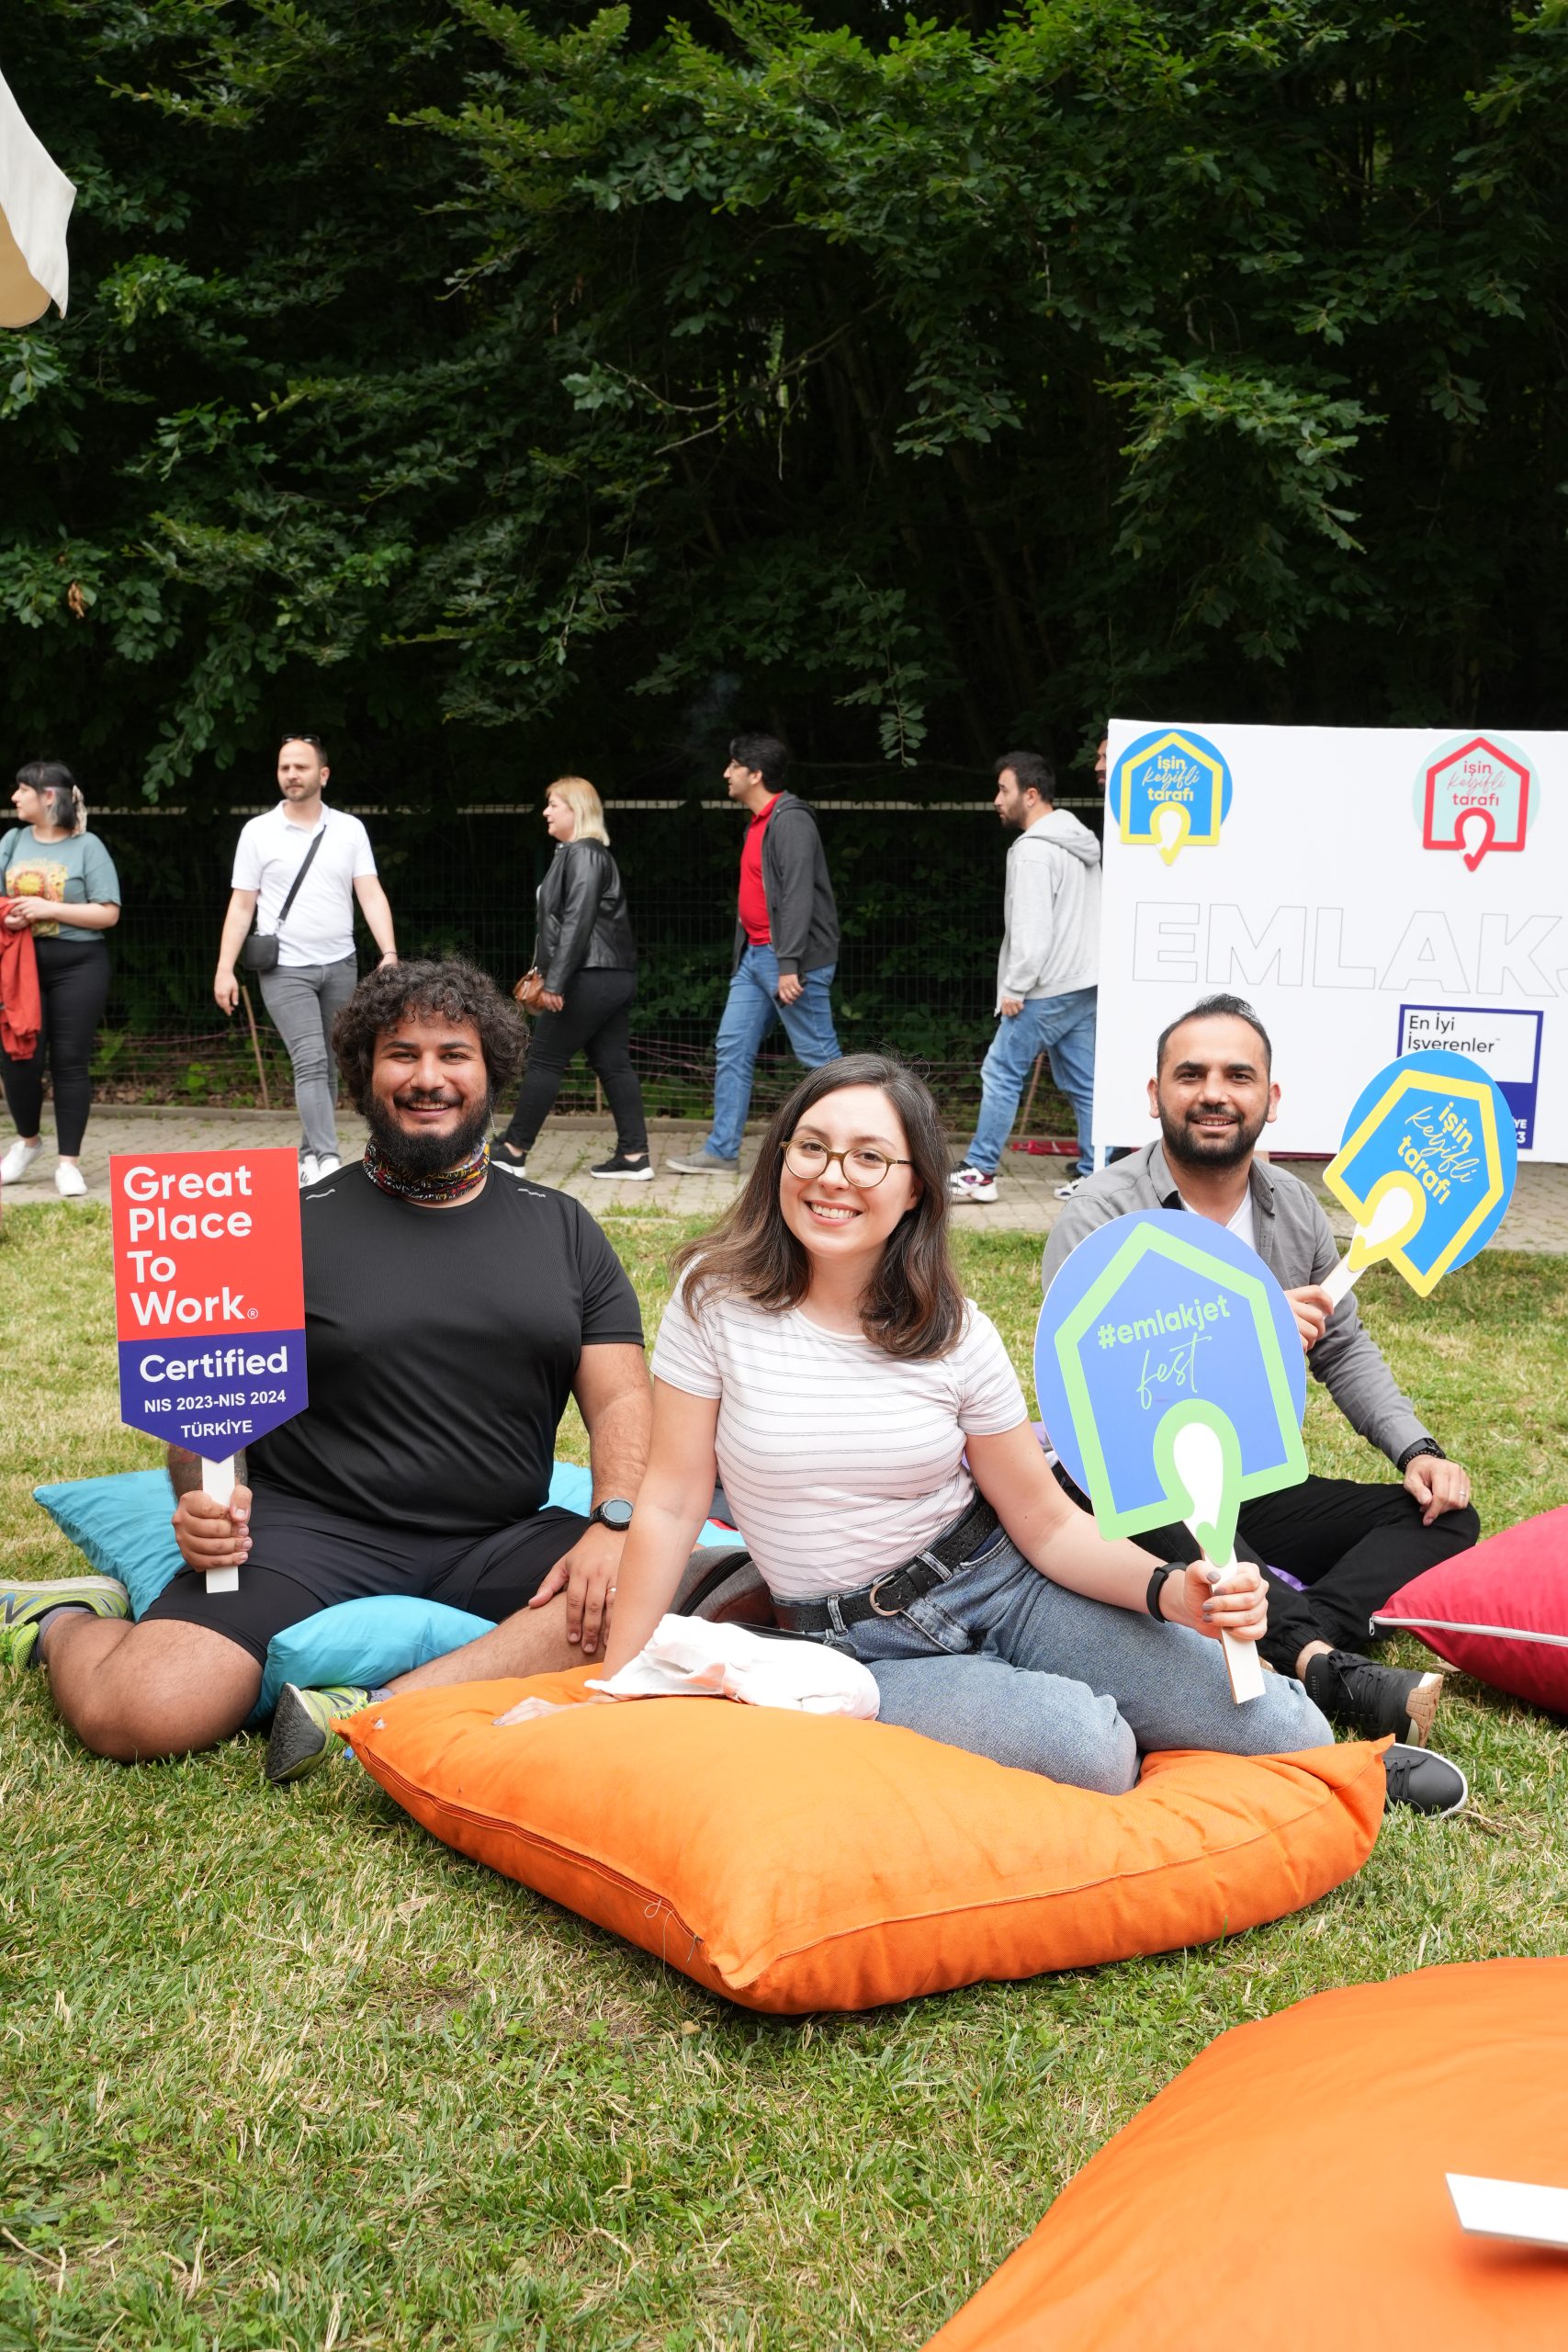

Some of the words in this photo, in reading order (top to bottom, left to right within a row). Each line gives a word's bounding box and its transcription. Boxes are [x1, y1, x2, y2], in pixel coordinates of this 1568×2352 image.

[1157, 755, 1186, 773] işin
[1463, 761, 1492, 776] işin
[1147, 787, 1194, 801] tarafı
[1452, 793, 1499, 807] tarafı
[1409, 1015, 1429, 1030] En
[1436, 1012, 1455, 1035] İyi
[1438, 1102, 1473, 1150] işin
[123, 1165, 253, 1202] Great
[1398, 1135, 1451, 1205] tarafı
[129, 1207, 253, 1243] Place
[127, 1250, 176, 1283] To
[1098, 1295, 1231, 1349] #emlakjet
[140, 1346, 288, 1383] Certified
[1136, 1332, 1213, 1409] fest
[144, 1398, 172, 1413] NIS
[176, 1393, 245, 1411] 2023-NIS
[250, 1389, 287, 1405] 2024
[181, 1419, 253, 1438] TÜRKİYE
